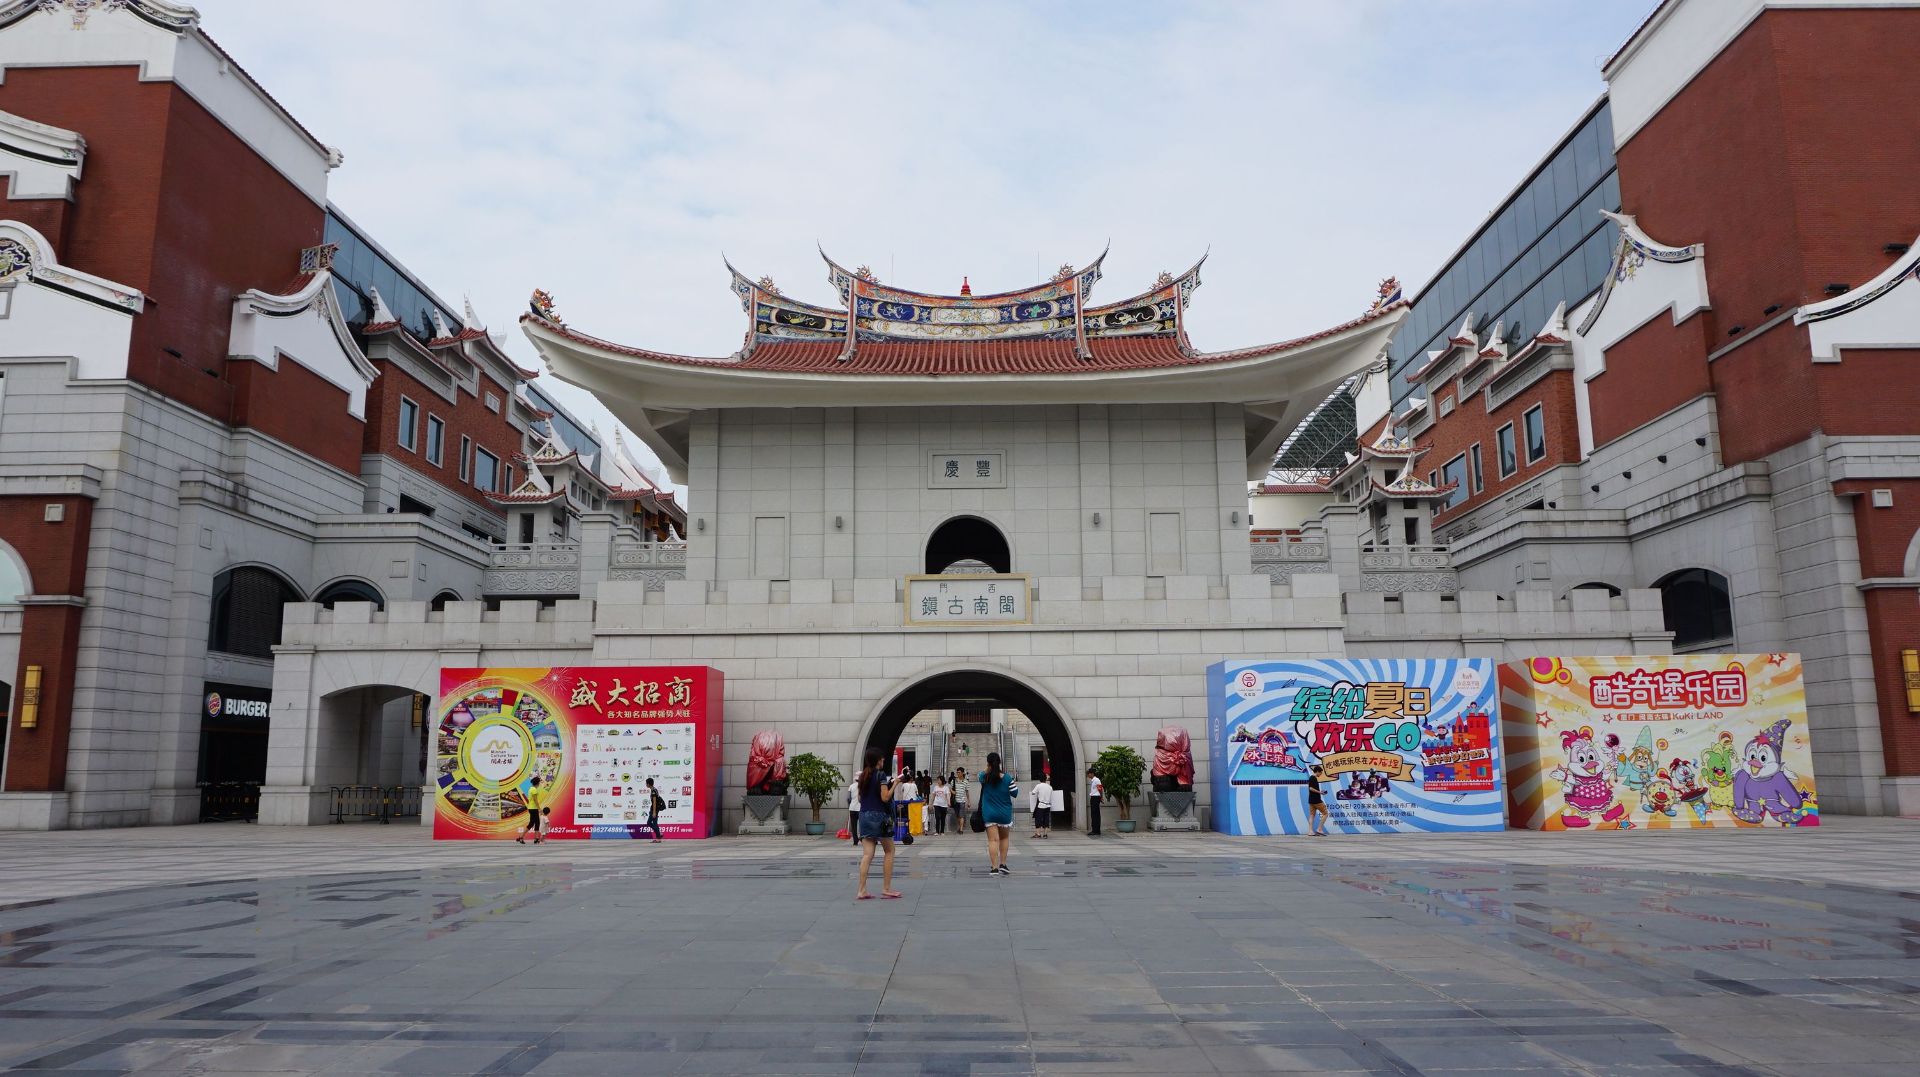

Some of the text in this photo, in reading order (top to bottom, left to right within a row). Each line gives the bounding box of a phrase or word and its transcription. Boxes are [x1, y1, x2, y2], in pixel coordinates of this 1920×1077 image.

[568, 677, 693, 714] 盛大招商
[1290, 682, 1431, 721] 缤纷夏日
[1593, 671, 1745, 706] 酷奇堡乐园
[225, 698, 268, 718] BURGER
[1697, 712, 1724, 720] LAND
[1310, 722, 1422, 753] 欢乐GO
[1247, 750, 1295, 764] 水上乐园
